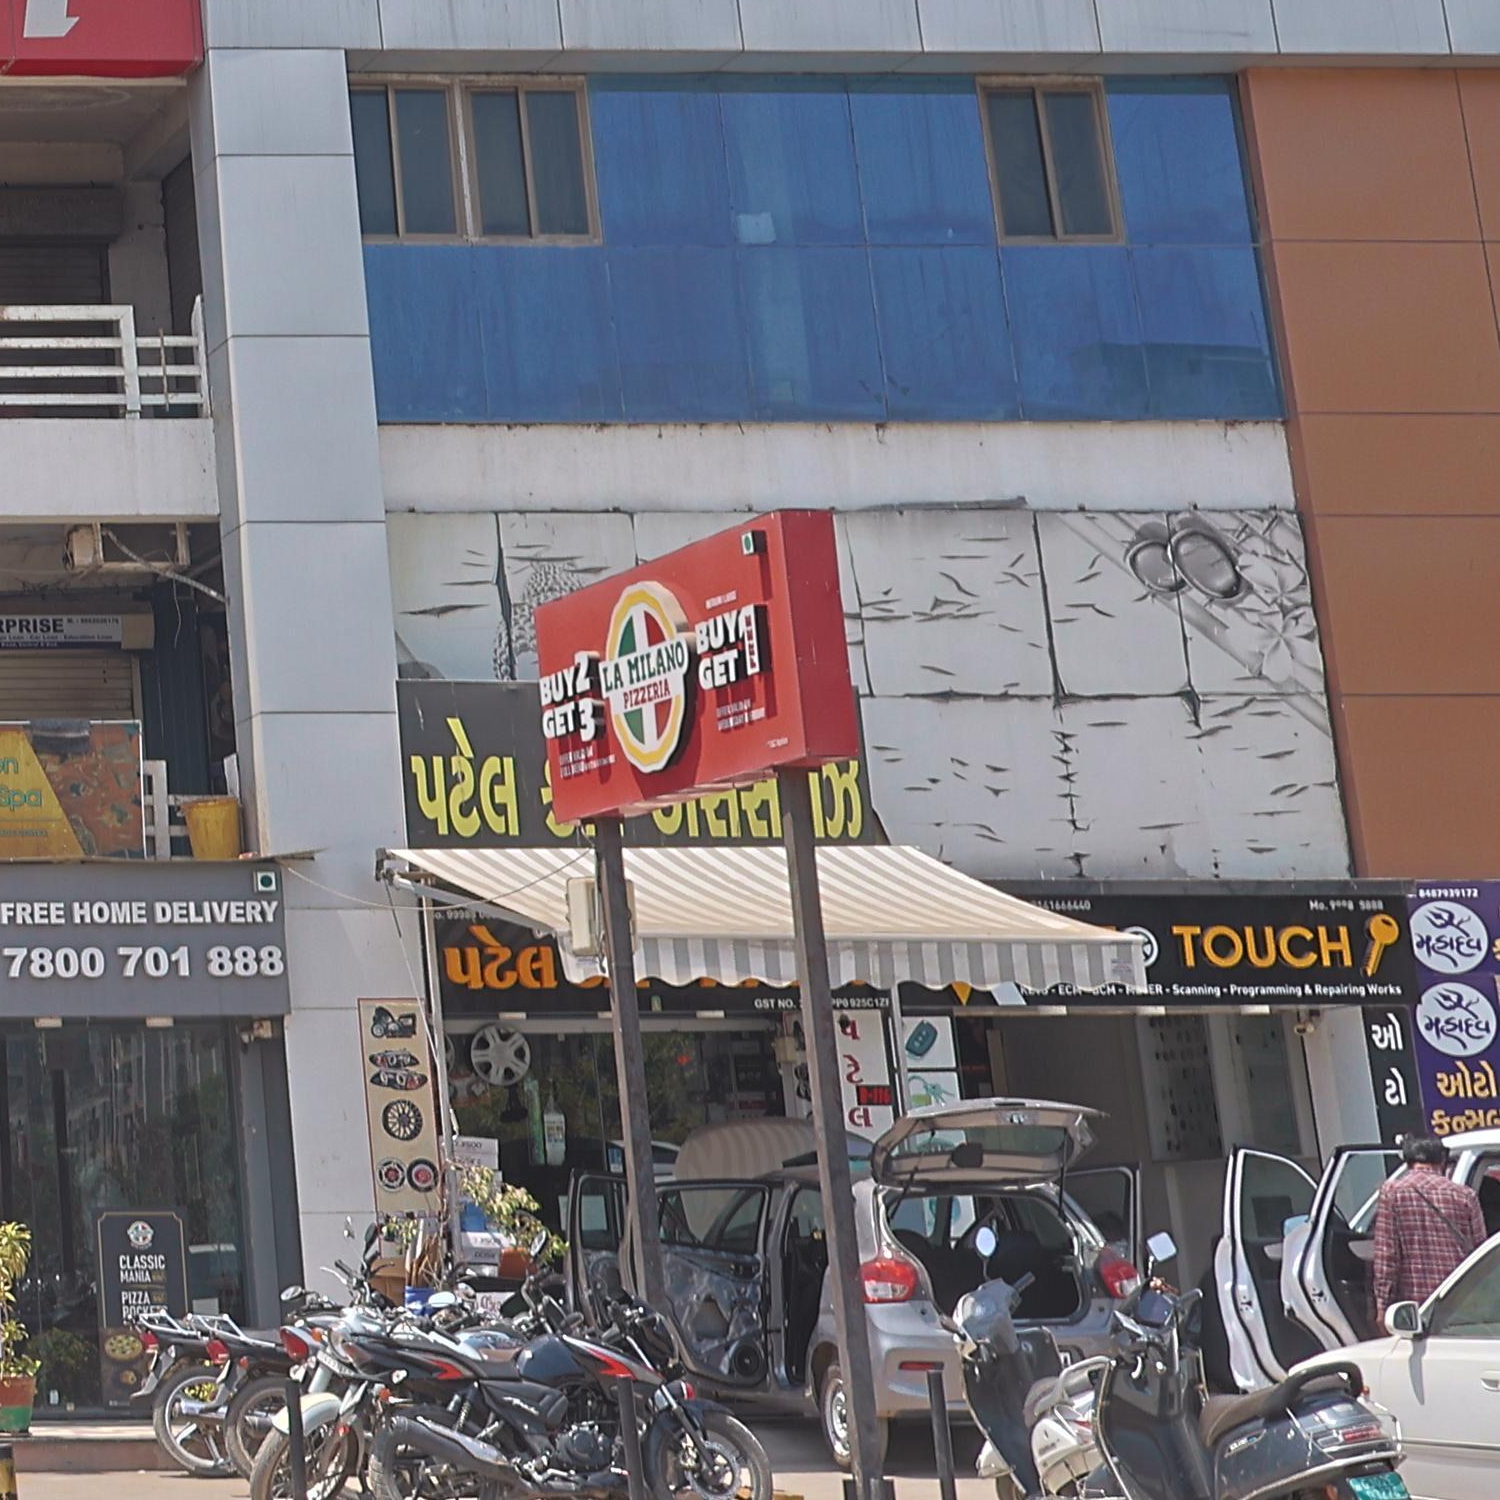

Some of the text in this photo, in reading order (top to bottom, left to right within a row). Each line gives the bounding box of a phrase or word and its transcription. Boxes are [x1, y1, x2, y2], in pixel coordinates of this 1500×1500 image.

[695, 612, 735, 655] BUY
[602, 641, 685, 692] LA MILANO
[699, 649, 739, 690] GET
[539, 667, 575, 706] BUY
[623, 681, 671, 709] PIZZERIA
[542, 699, 596, 742] GET 3
[410, 717, 519, 838] પટેલ
[0, 901, 278, 925] FREE HOME DELIVERY
[3, 945, 284, 979] 7800 701 888
[444, 925, 558, 990] પટેલ
[1172, 925, 1353, 968] TOUCH
[754, 998, 796, 1008] GST NO.
[1172, 983, 1402, 998] Scanning Programming & Repairing Works
[1436, 1060, 1497, 1099] ઓટો
[119, 1254, 165, 1269] CLASSIC
[120, 1270, 151, 1283] MANIA
[121, 1291, 151, 1304] PIZZA
